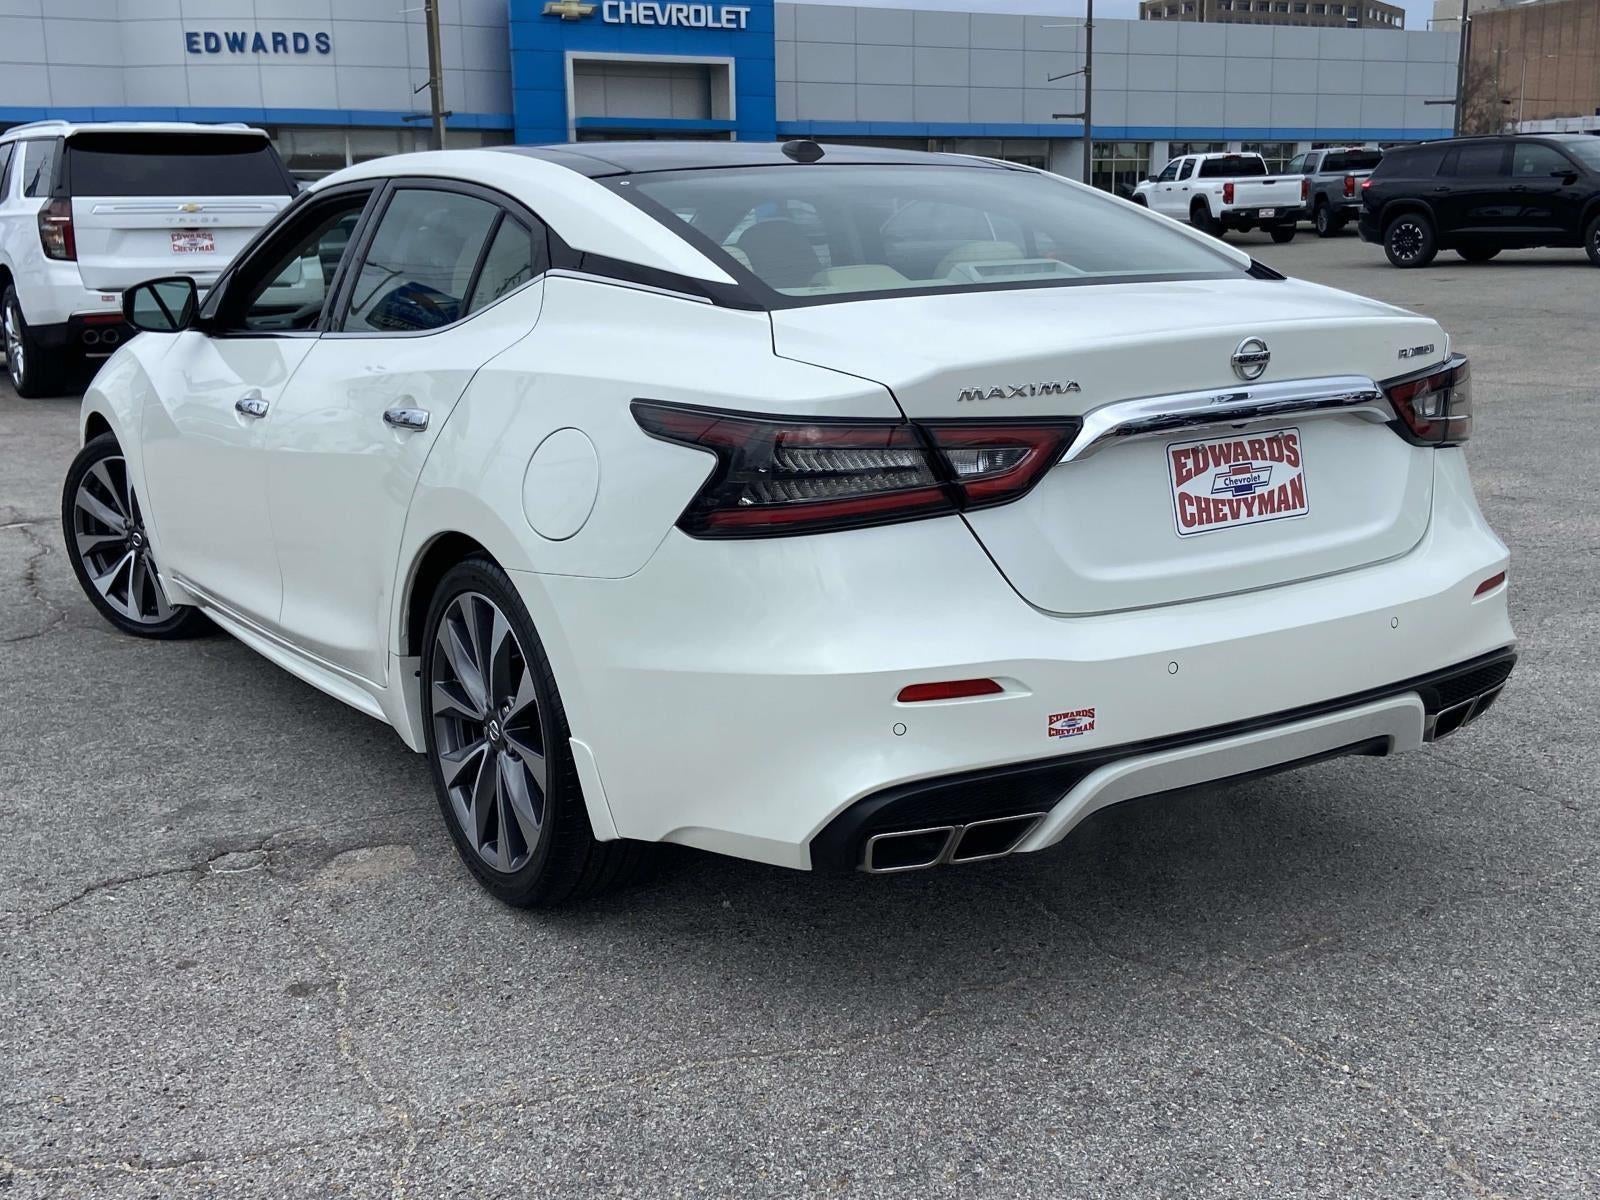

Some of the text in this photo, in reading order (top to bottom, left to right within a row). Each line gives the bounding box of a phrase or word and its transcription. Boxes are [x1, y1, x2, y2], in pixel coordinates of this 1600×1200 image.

[602, 1, 751, 29] CHEVROLET
[185, 32, 331, 55] EDWARDS
[171, 232, 213, 242] EDWARDS
[172, 243, 215, 252] CHEVYMAN
[957, 380, 1081, 401] MAXIMA
[1172, 433, 1300, 488] EDWARDS
[1223, 474, 1261, 487] Chevrolet
[1178, 472, 1305, 528] CHEVYMAN
[1048, 707, 1095, 726] EDWARDS
[1048, 719, 1095, 737] CHEVYMAN
